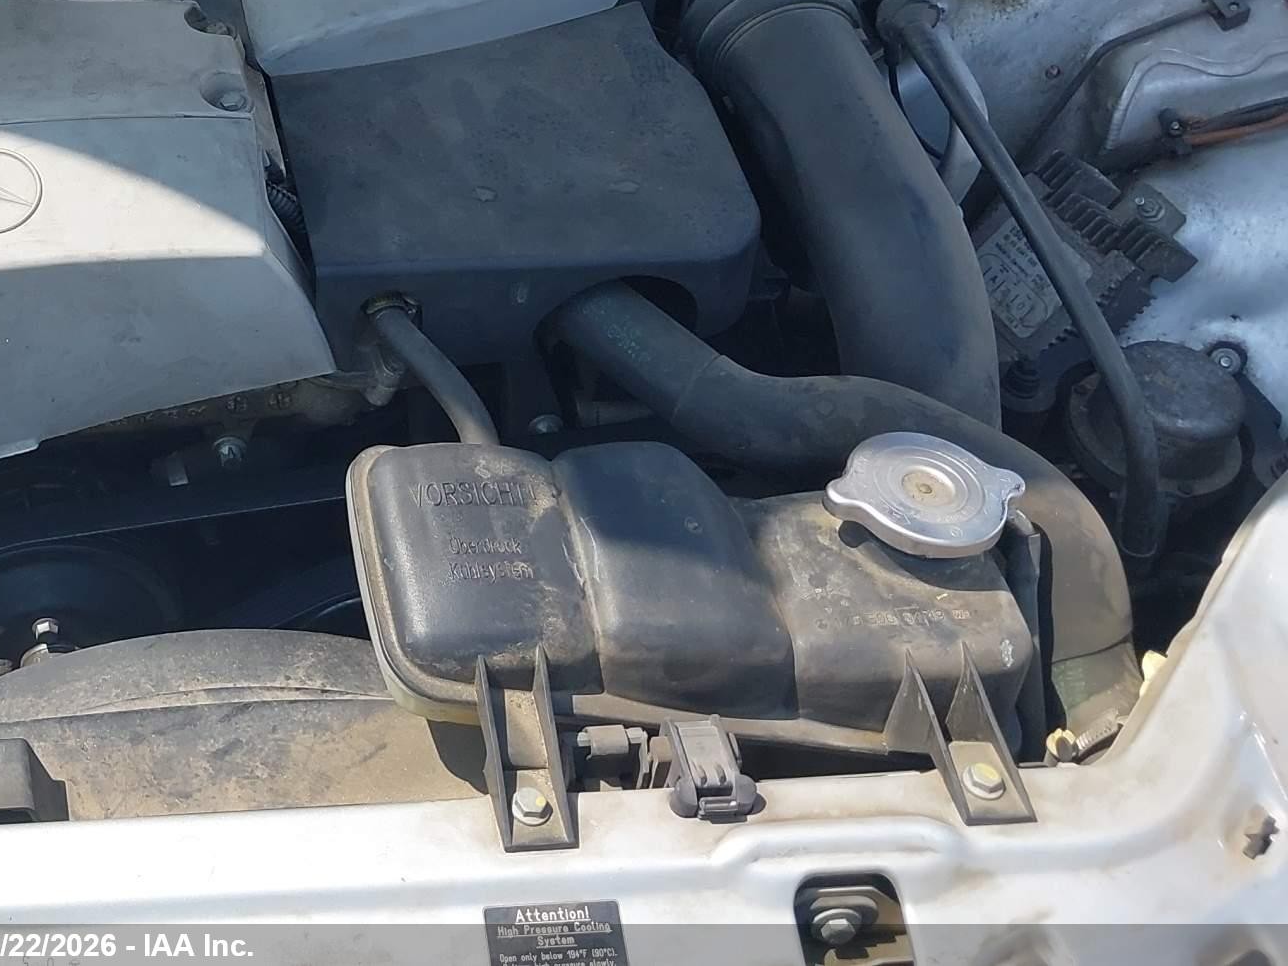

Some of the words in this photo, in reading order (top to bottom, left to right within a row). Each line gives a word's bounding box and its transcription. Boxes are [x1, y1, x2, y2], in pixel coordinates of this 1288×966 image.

[516, 905, 590, 923] Attention!
[497, 925, 519, 938] High
[523, 923, 569, 935] Pressure
[573, 920, 611, 933] Cooling
[536, 935, 576, 948] System
[499, 953, 518, 964] Open
[520, 952, 538, 963] only
[540, 951, 563, 961] below
